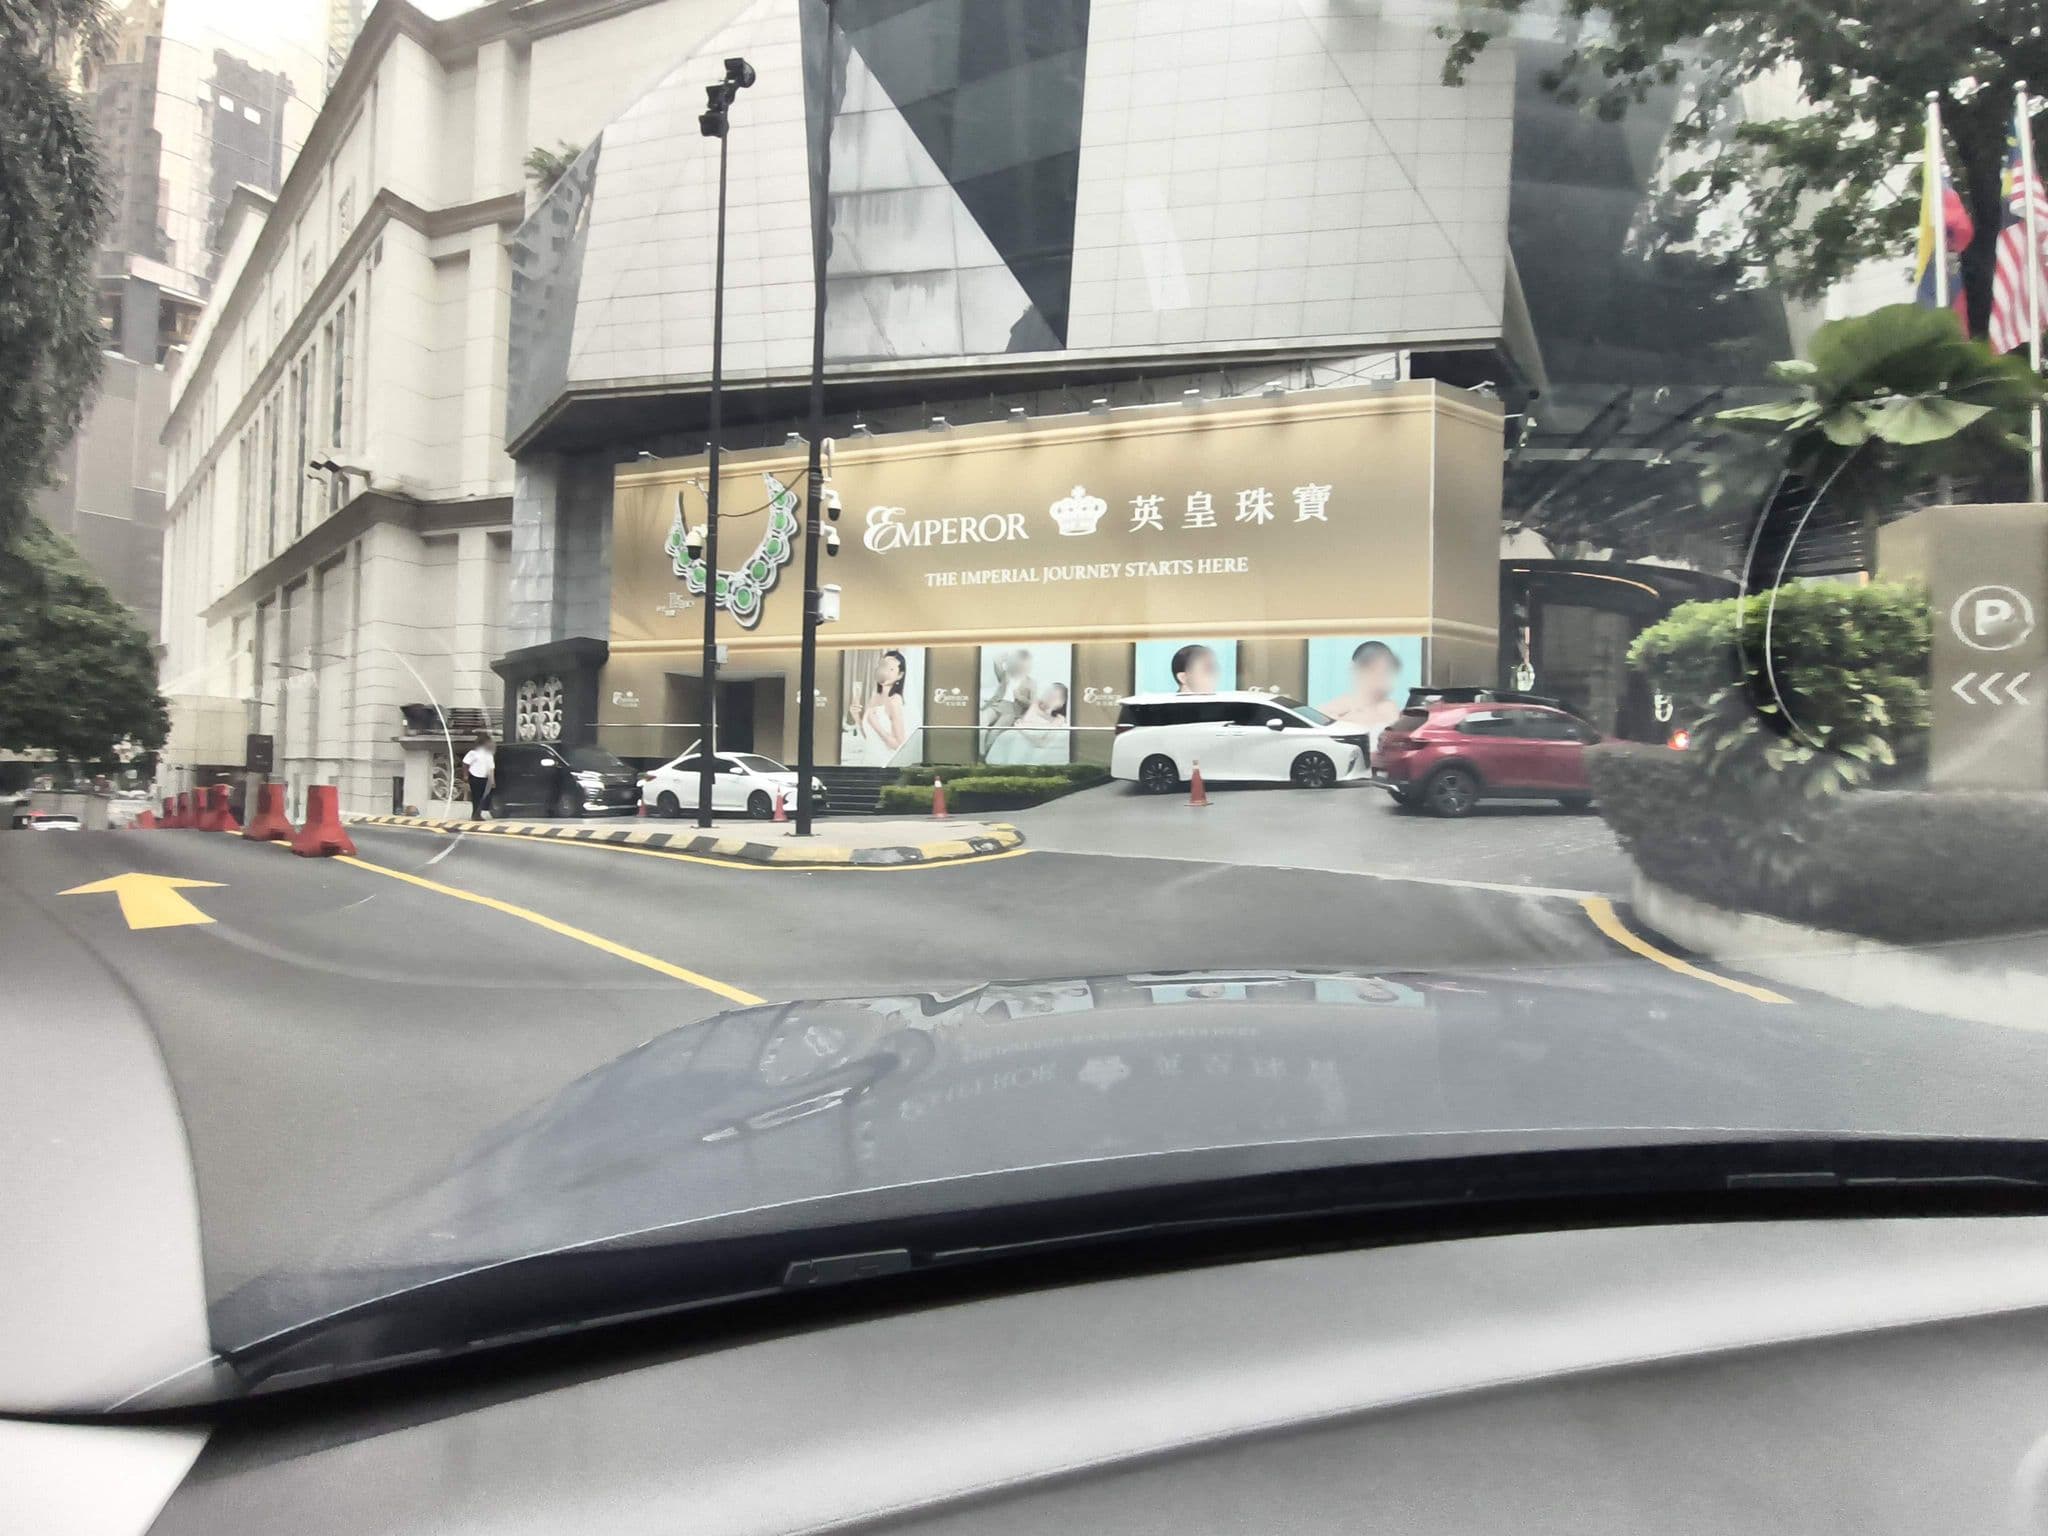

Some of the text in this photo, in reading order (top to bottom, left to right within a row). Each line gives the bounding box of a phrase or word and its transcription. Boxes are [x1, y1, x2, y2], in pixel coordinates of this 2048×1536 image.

[1127, 482, 1333, 533] 英皇珠寶
[863, 505, 1030, 554] EMPEROR
[924, 557, 1249, 587] THE IMPERIAL JOURNEY STARTS HERE
[1974, 599, 2014, 636] P
